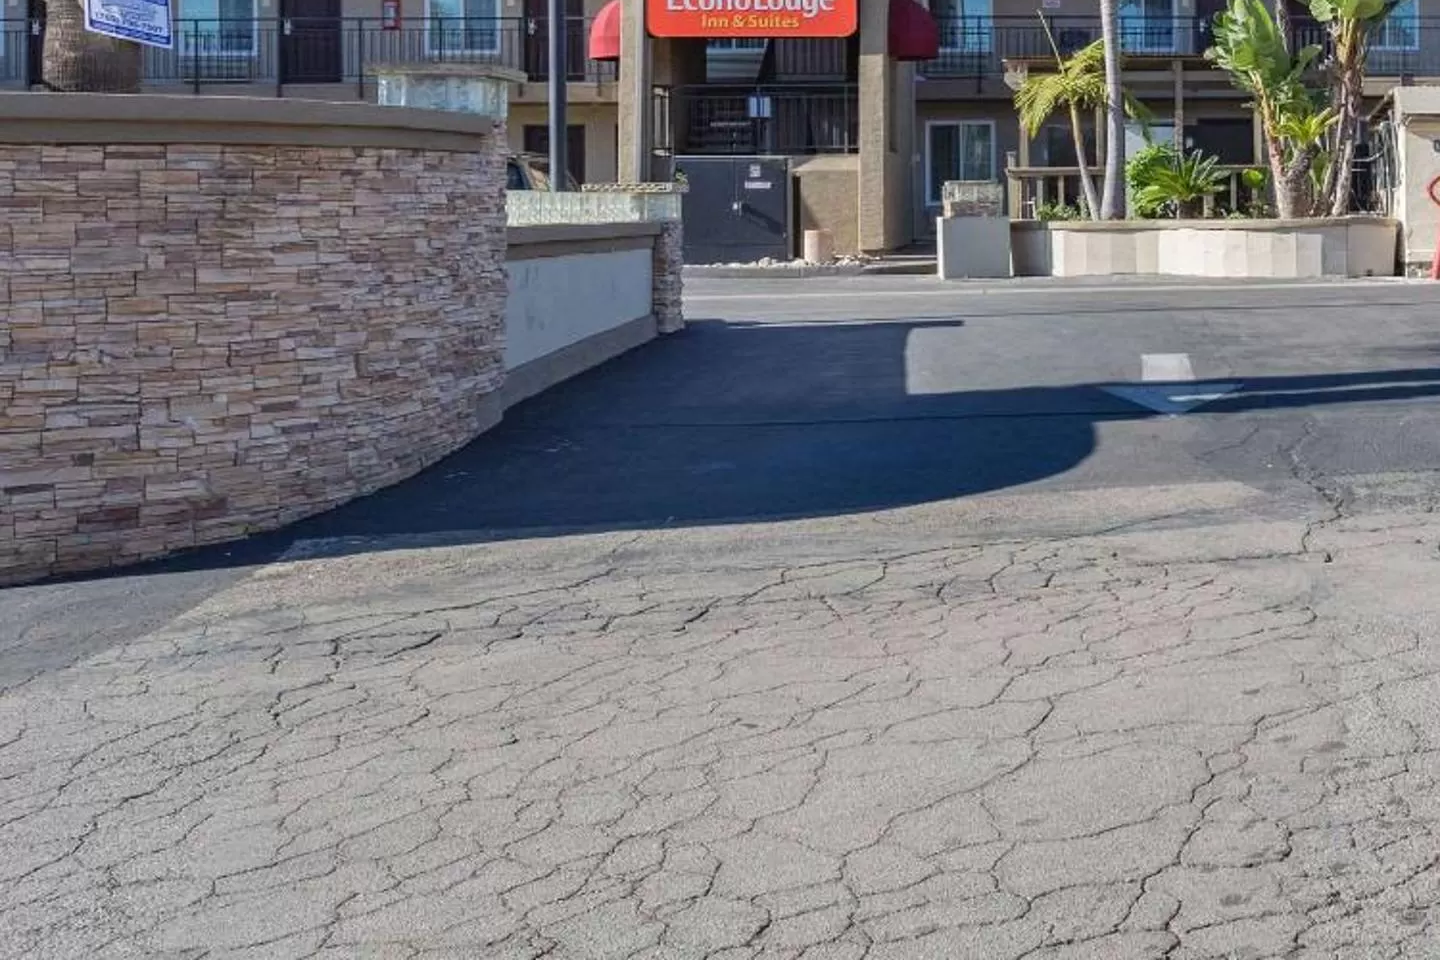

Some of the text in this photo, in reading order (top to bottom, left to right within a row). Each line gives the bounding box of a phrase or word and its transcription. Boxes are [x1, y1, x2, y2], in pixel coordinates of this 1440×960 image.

[702, 14, 800, 28] Inn & Suites
